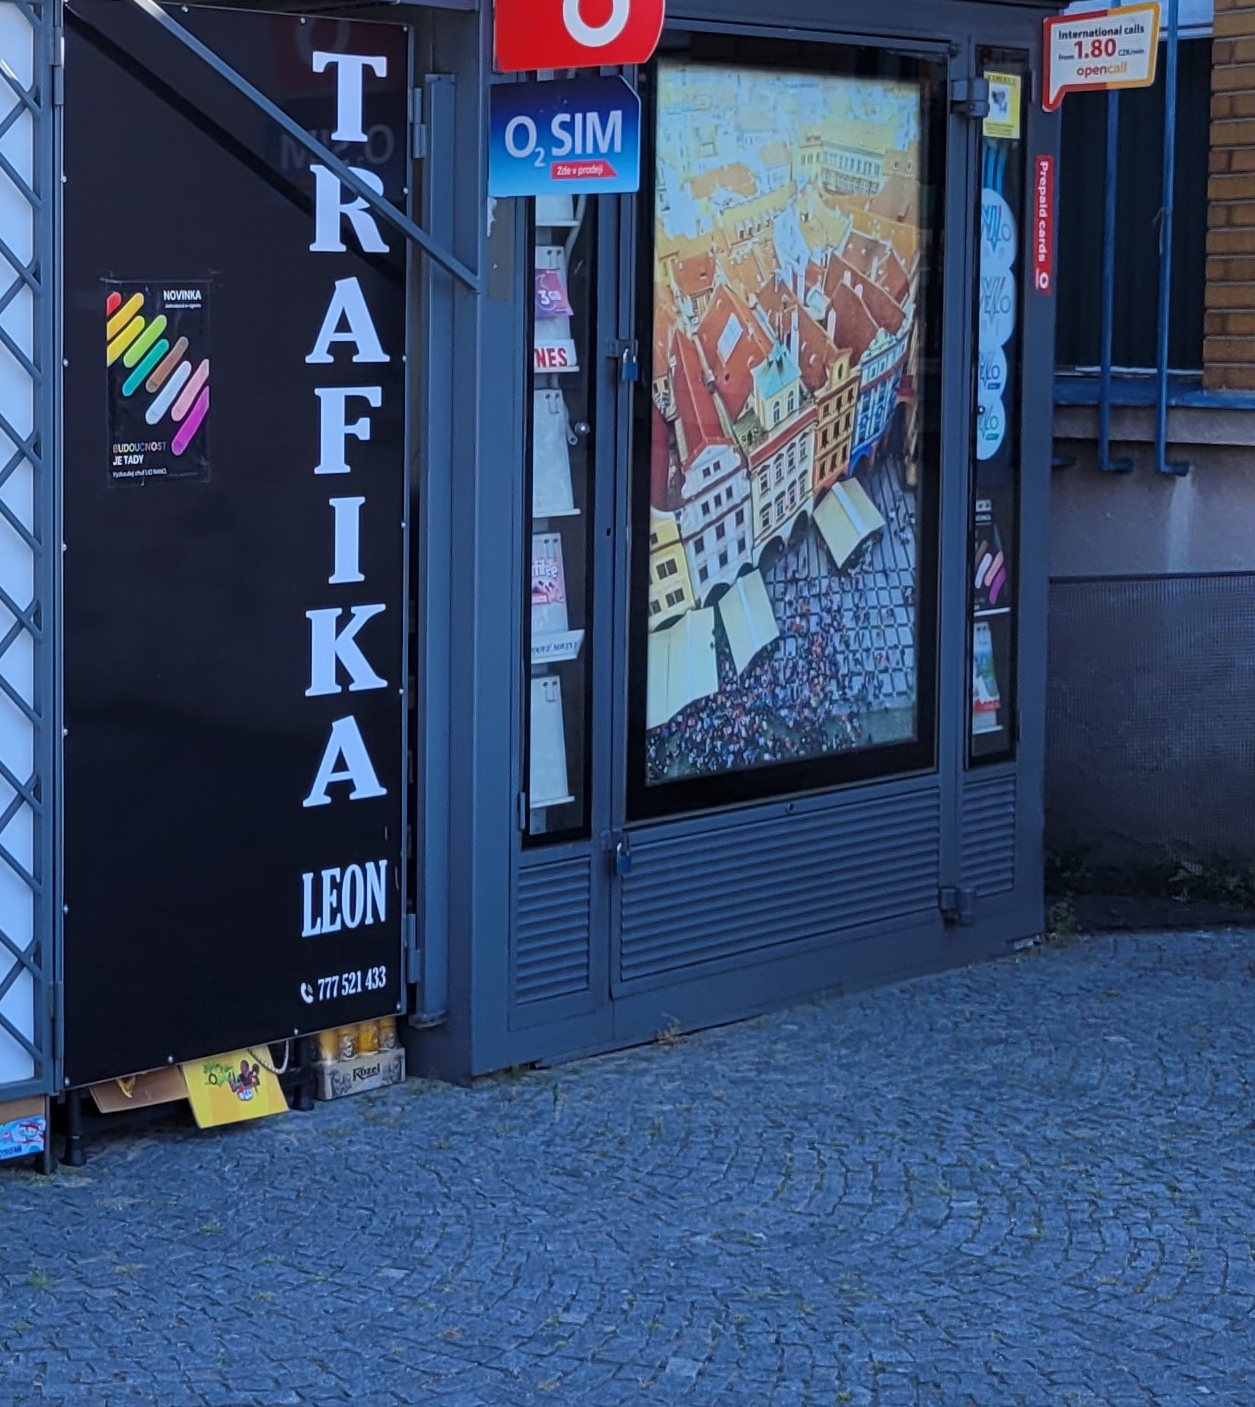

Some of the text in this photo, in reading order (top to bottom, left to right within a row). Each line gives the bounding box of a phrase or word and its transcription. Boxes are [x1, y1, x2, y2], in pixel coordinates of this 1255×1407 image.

[1058, 21, 1145, 40] International calls
[1074, 39, 1117, 60] 1.80
[1077, 62, 1127, 79] opencall
[550, 110, 623, 157] SIM
[556, 165, 570, 176] Zde
[1036, 160, 1050, 217] Prepaid
[1038, 221, 1048, 263] cards
[163, 290, 202, 301] NOVINKA
[305, 50, 391, 810] TRAFIKA
[112, 442, 167, 454] BUDOUCNOST
[112, 454, 144, 466] JE TADY
[302, 860, 387, 938] LEON
[317, 966, 387, 1002] 777 521 433
[352, 1063, 381, 1082] Kozel
